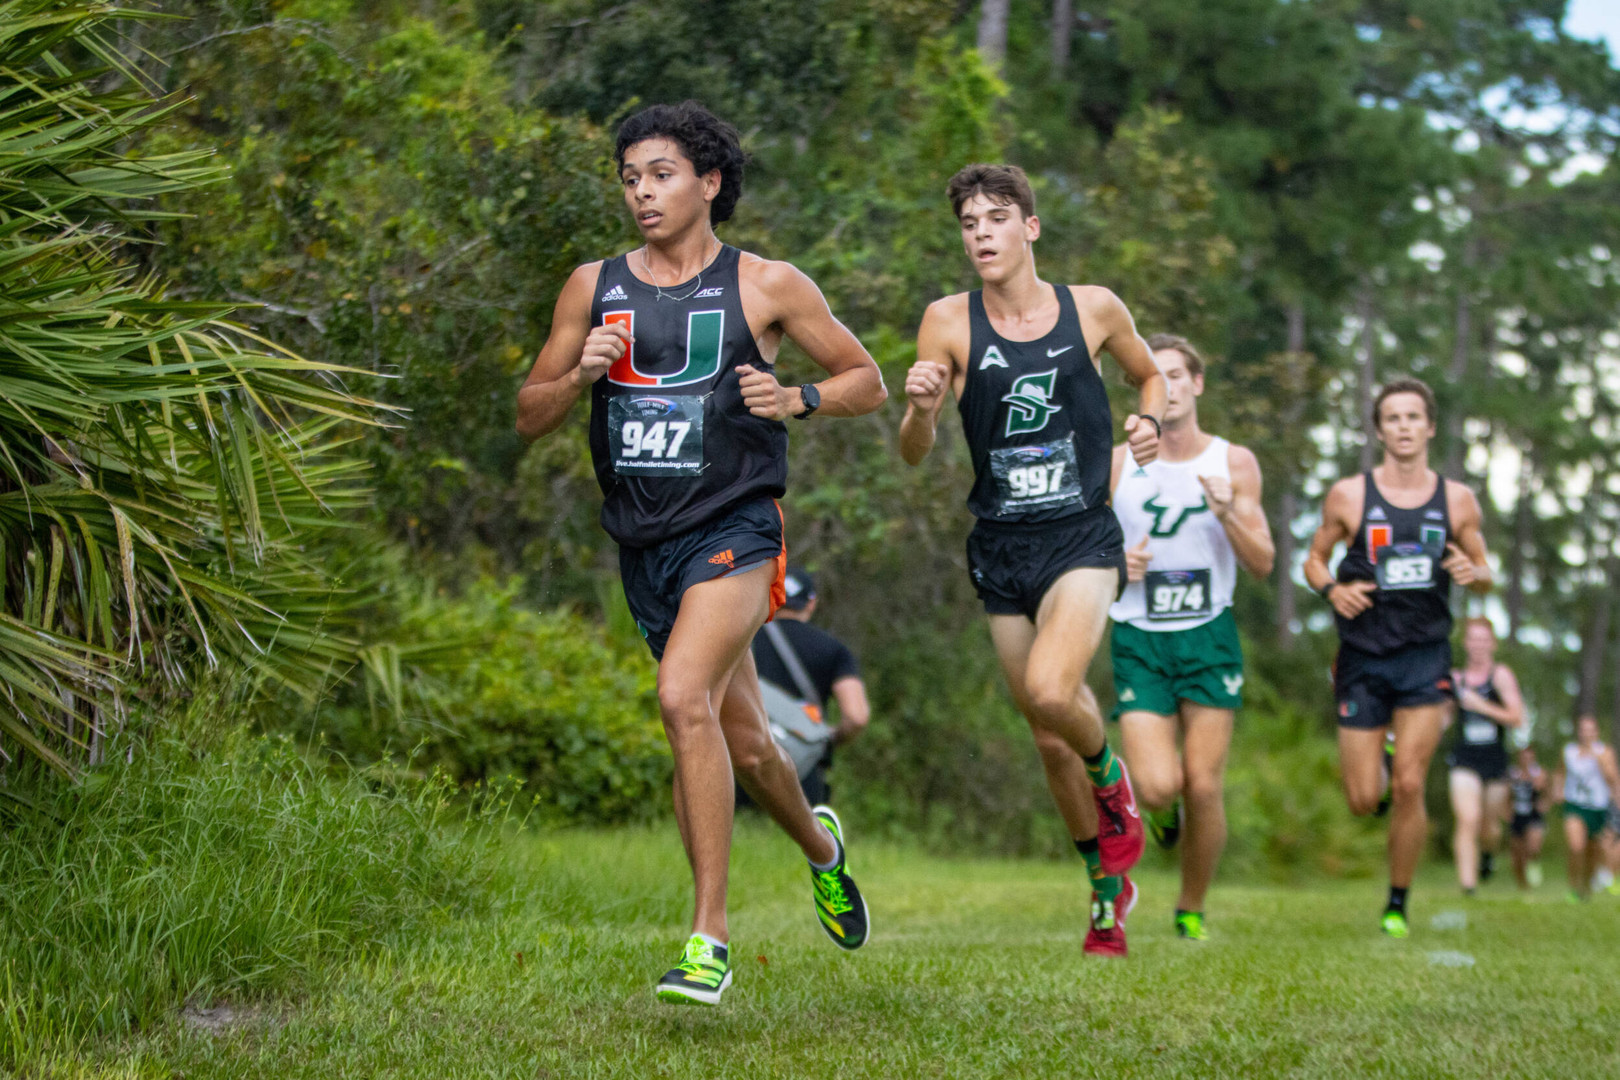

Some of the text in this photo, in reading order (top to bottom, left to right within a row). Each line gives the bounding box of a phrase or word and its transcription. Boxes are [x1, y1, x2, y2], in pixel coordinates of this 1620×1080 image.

[601, 293, 628, 302] adidas
[693, 287, 724, 298] ACC
[602, 309, 725, 388] U
[621, 421, 692, 458] 947
[1008, 461, 1066, 498] 997
[1385, 556, 1433, 585] 953
[1153, 582, 1204, 612] 974
